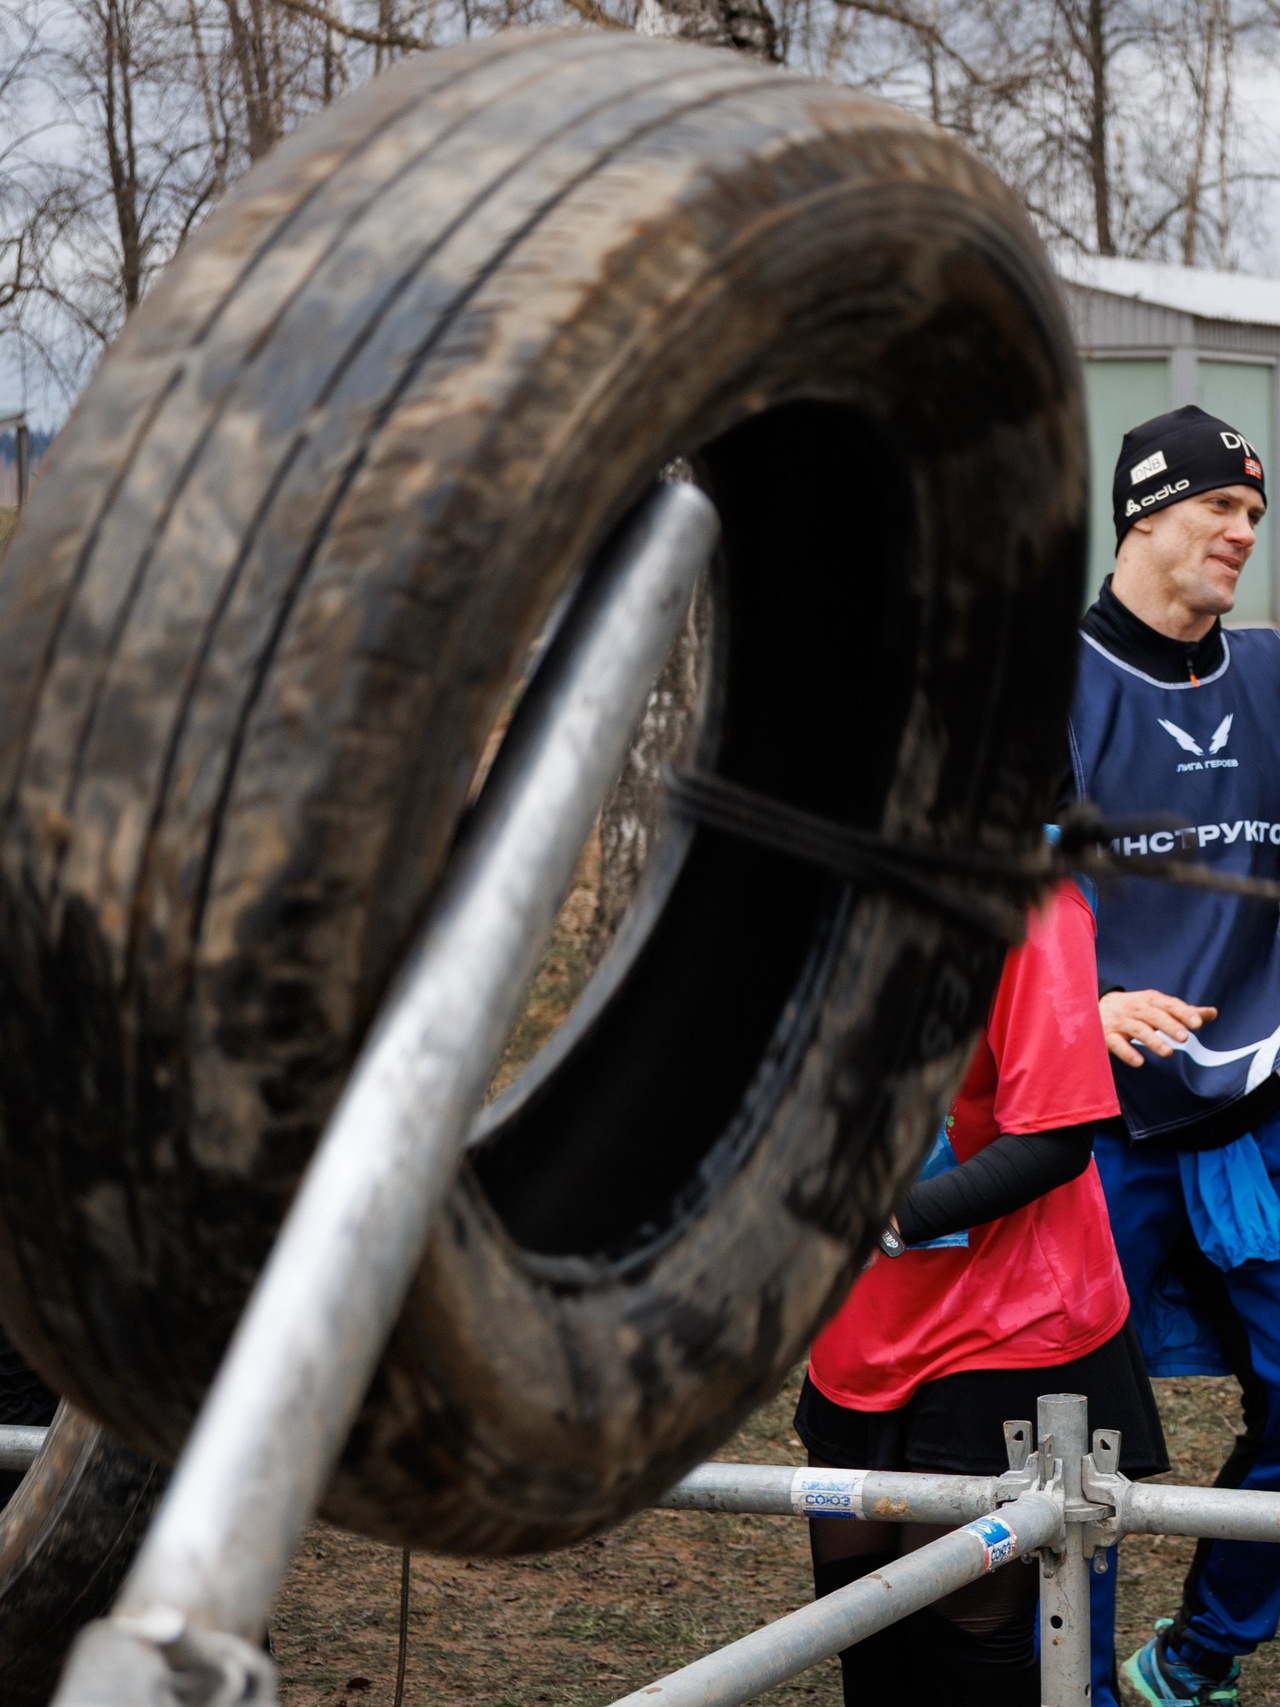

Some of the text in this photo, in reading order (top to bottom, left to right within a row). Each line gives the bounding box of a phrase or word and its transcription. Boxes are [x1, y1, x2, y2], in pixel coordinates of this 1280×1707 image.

[1135, 457, 1162, 480] DNB
[1176, 758, 1239, 773] ЛИГА ГЕРОЕВ
